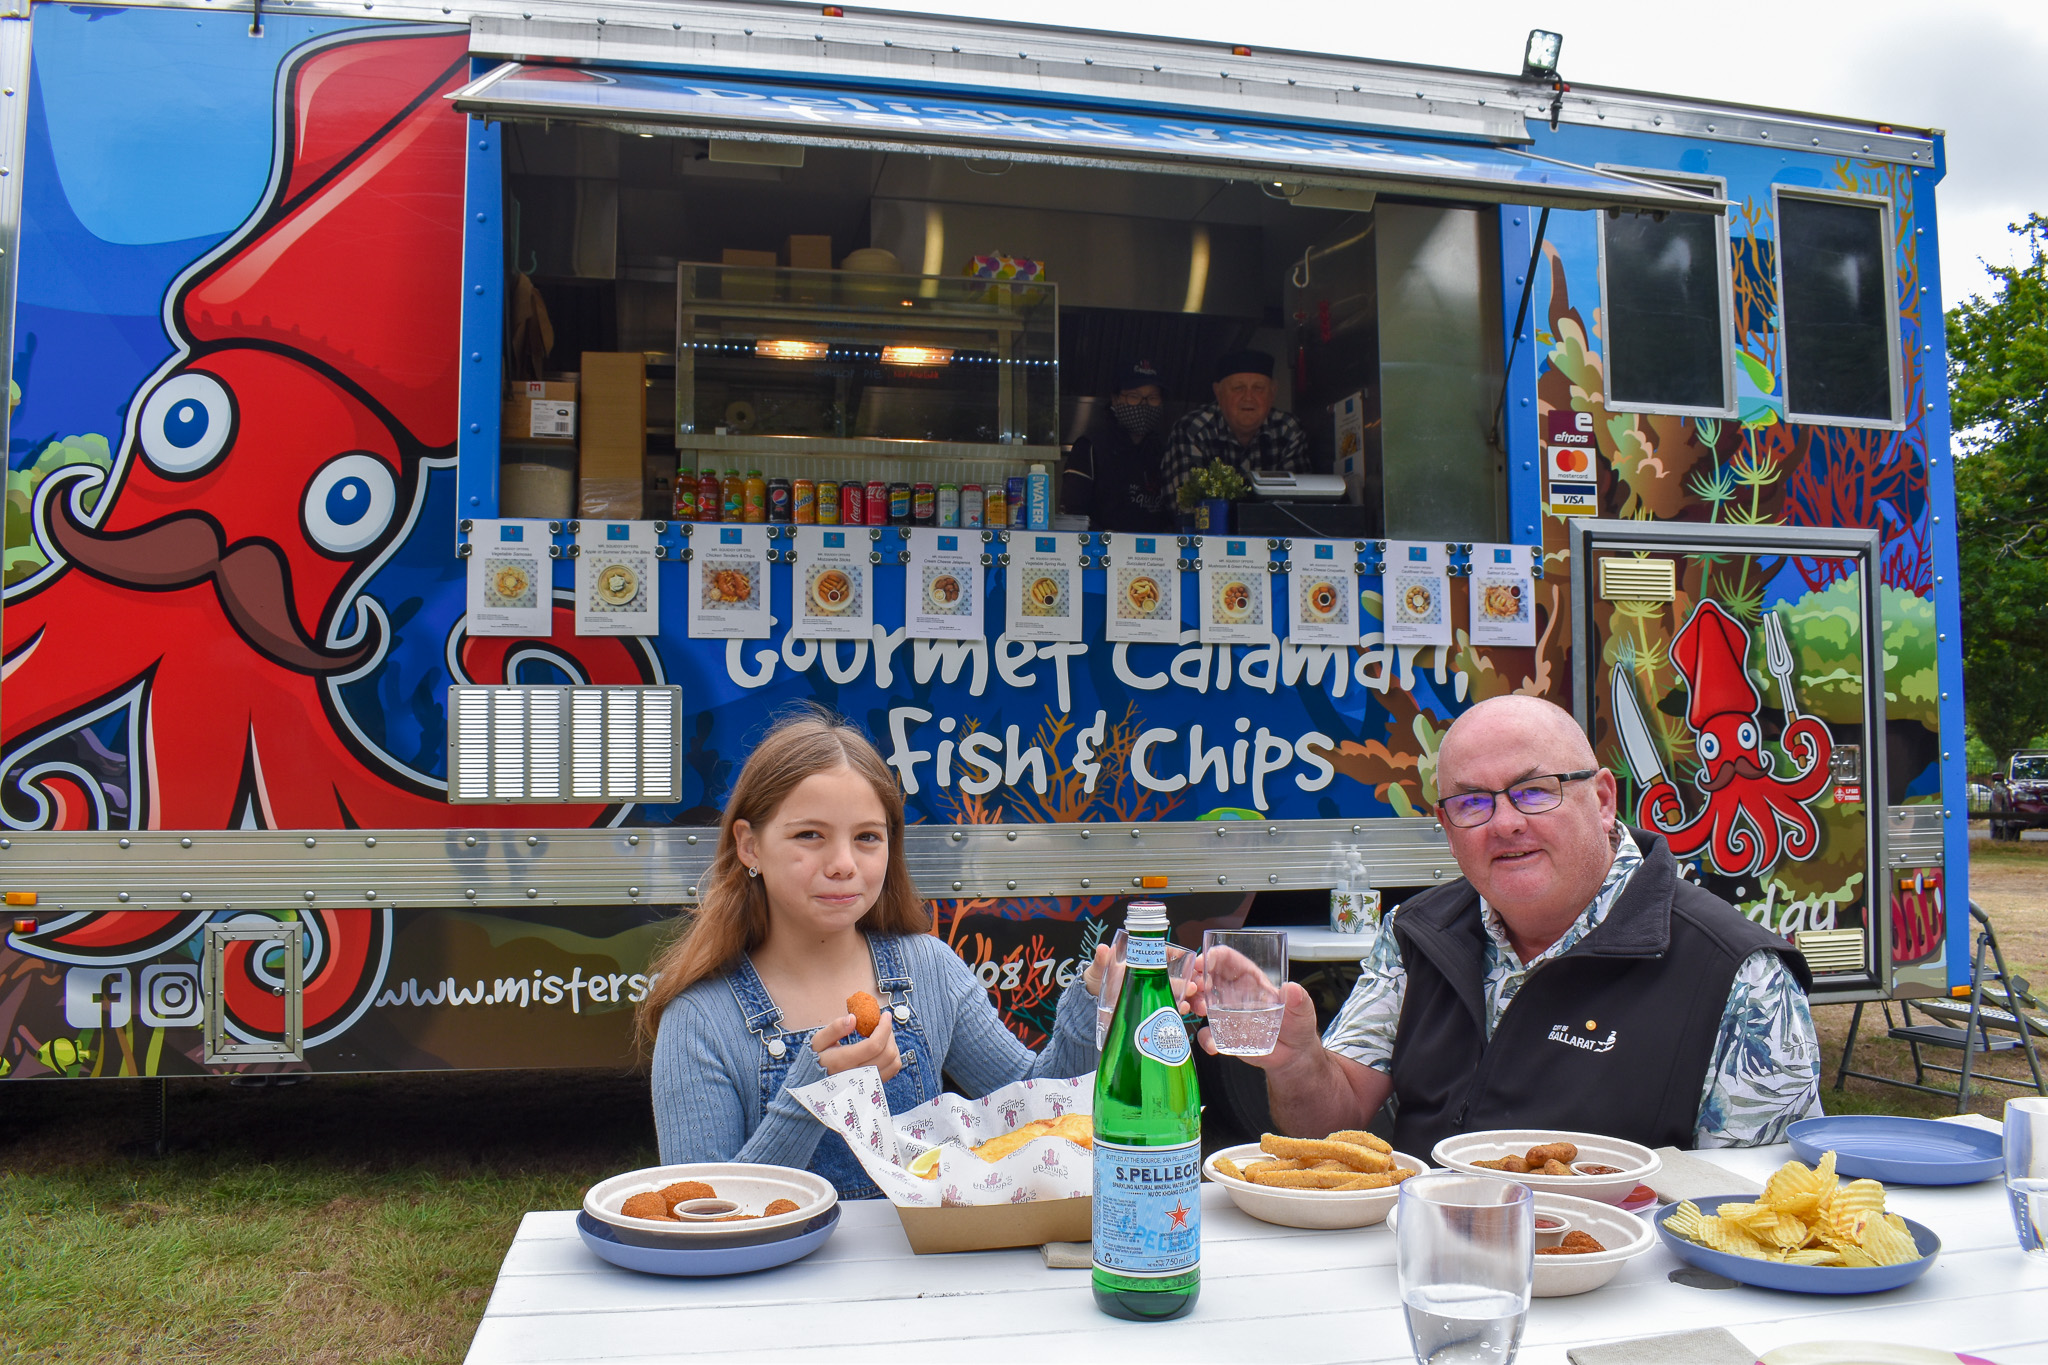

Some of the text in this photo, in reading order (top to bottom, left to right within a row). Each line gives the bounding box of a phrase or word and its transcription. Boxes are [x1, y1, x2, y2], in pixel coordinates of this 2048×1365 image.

[683, 85, 1396, 153] Delight your
[762, 104, 1148, 142] taste
[1554, 432, 1588, 443] eftpos
[1032, 481, 1045, 524] WATER
[1563, 496, 1584, 504] VISA
[726, 623, 1089, 713] Gourmet
[886, 706, 1335, 810] Fish & Chips
[1548, 1030, 1596, 1050] BALLARAT
[1106, 1154, 1123, 1162] BOTTLED
